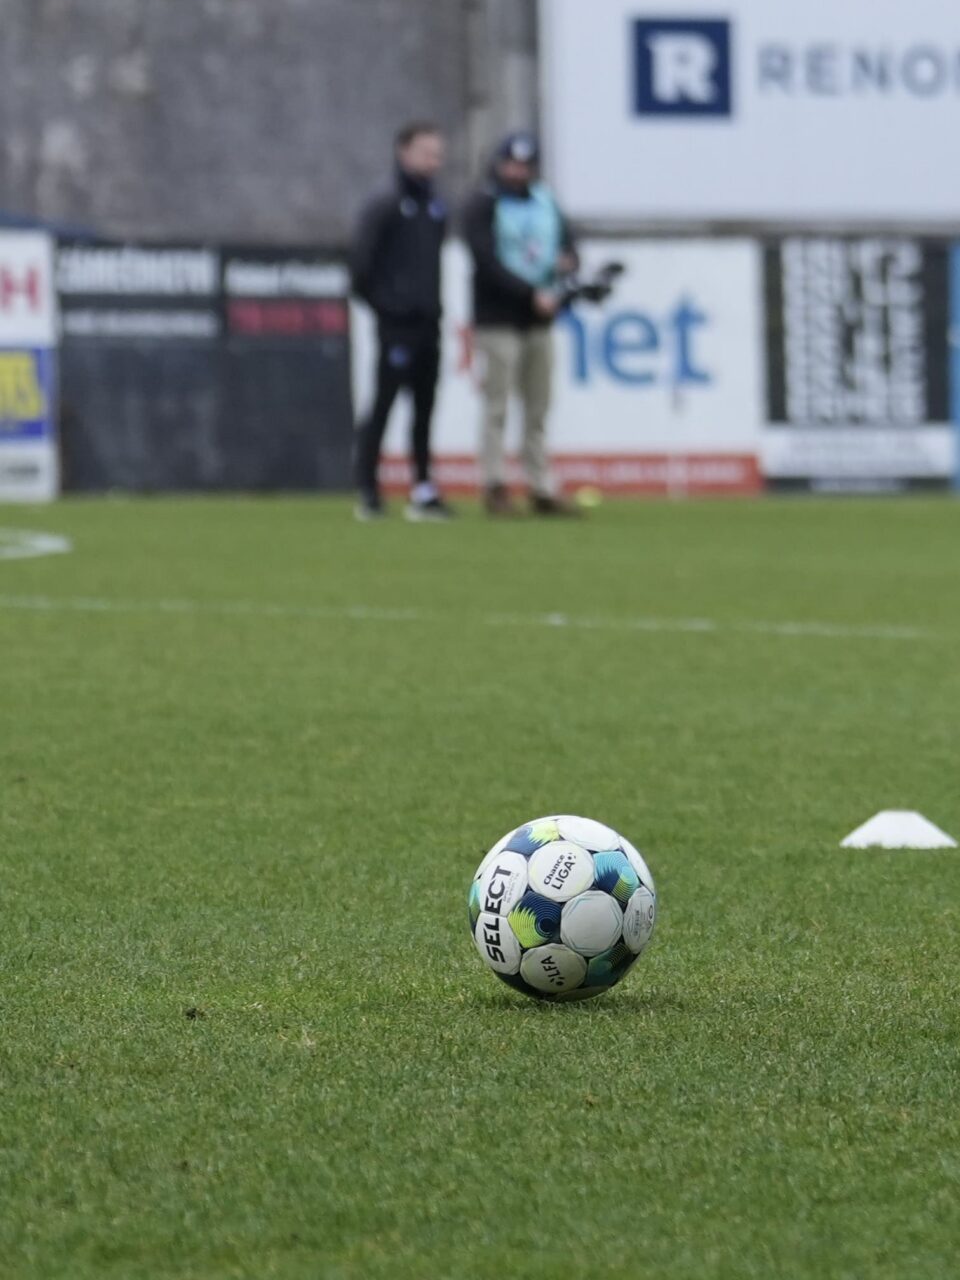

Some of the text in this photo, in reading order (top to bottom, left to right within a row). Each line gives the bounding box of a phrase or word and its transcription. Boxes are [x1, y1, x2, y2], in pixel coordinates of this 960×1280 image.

[648, 31, 719, 105] R
[543, 854, 565, 885] Chance
[551, 861, 575, 890] LIGA
[483, 865, 512, 963] SELECT
